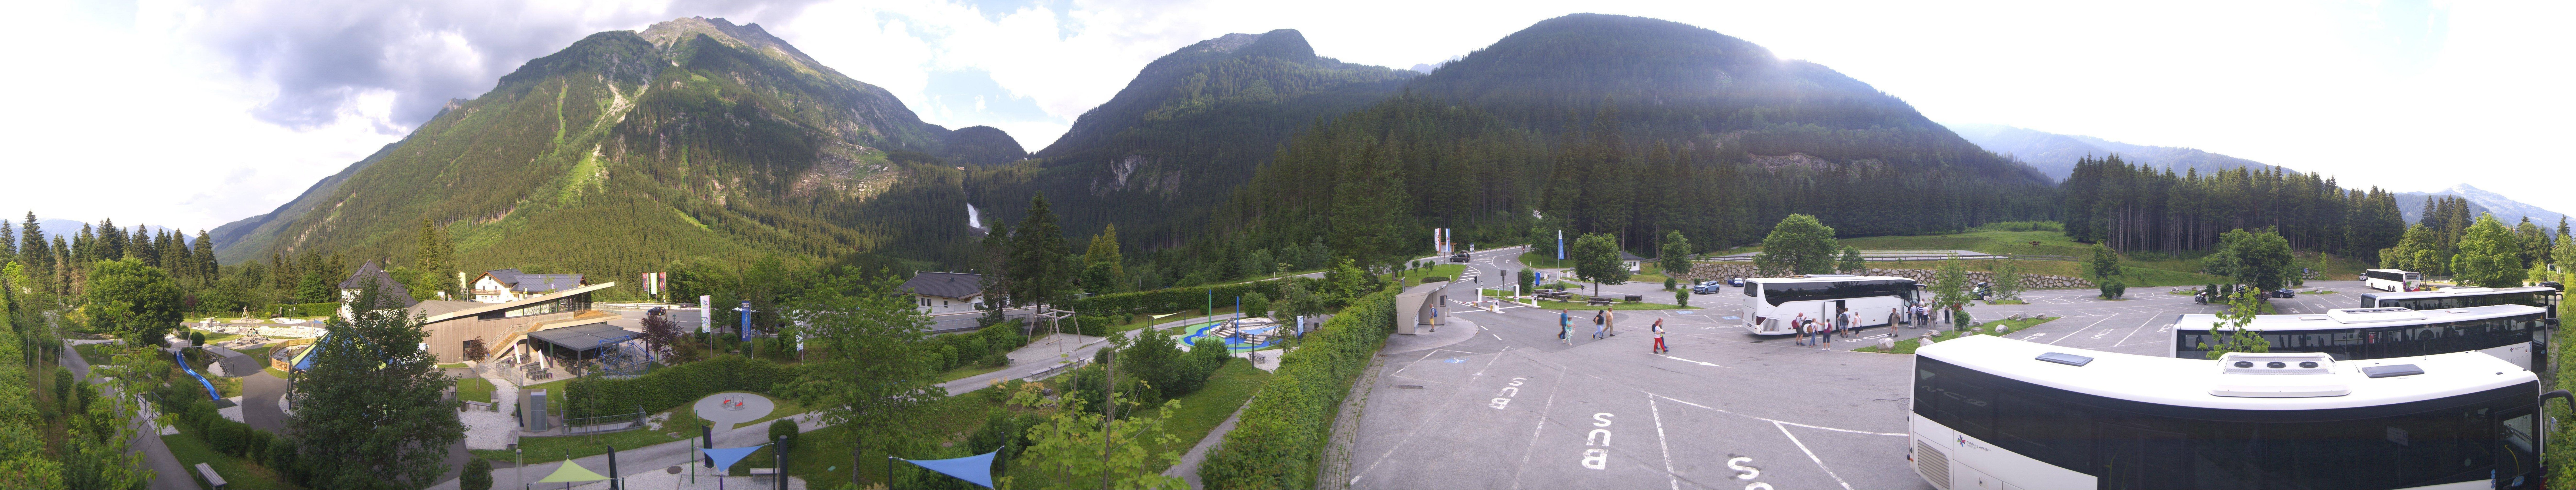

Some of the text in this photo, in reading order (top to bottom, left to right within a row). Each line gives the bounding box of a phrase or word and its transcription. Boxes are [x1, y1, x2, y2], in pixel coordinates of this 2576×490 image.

[2091, 328, 2114, 339] BUS
[2157, 323, 2174, 333] BUS
[1488, 377, 1527, 410] BUS
[1581, 413, 1614, 470] BUS
